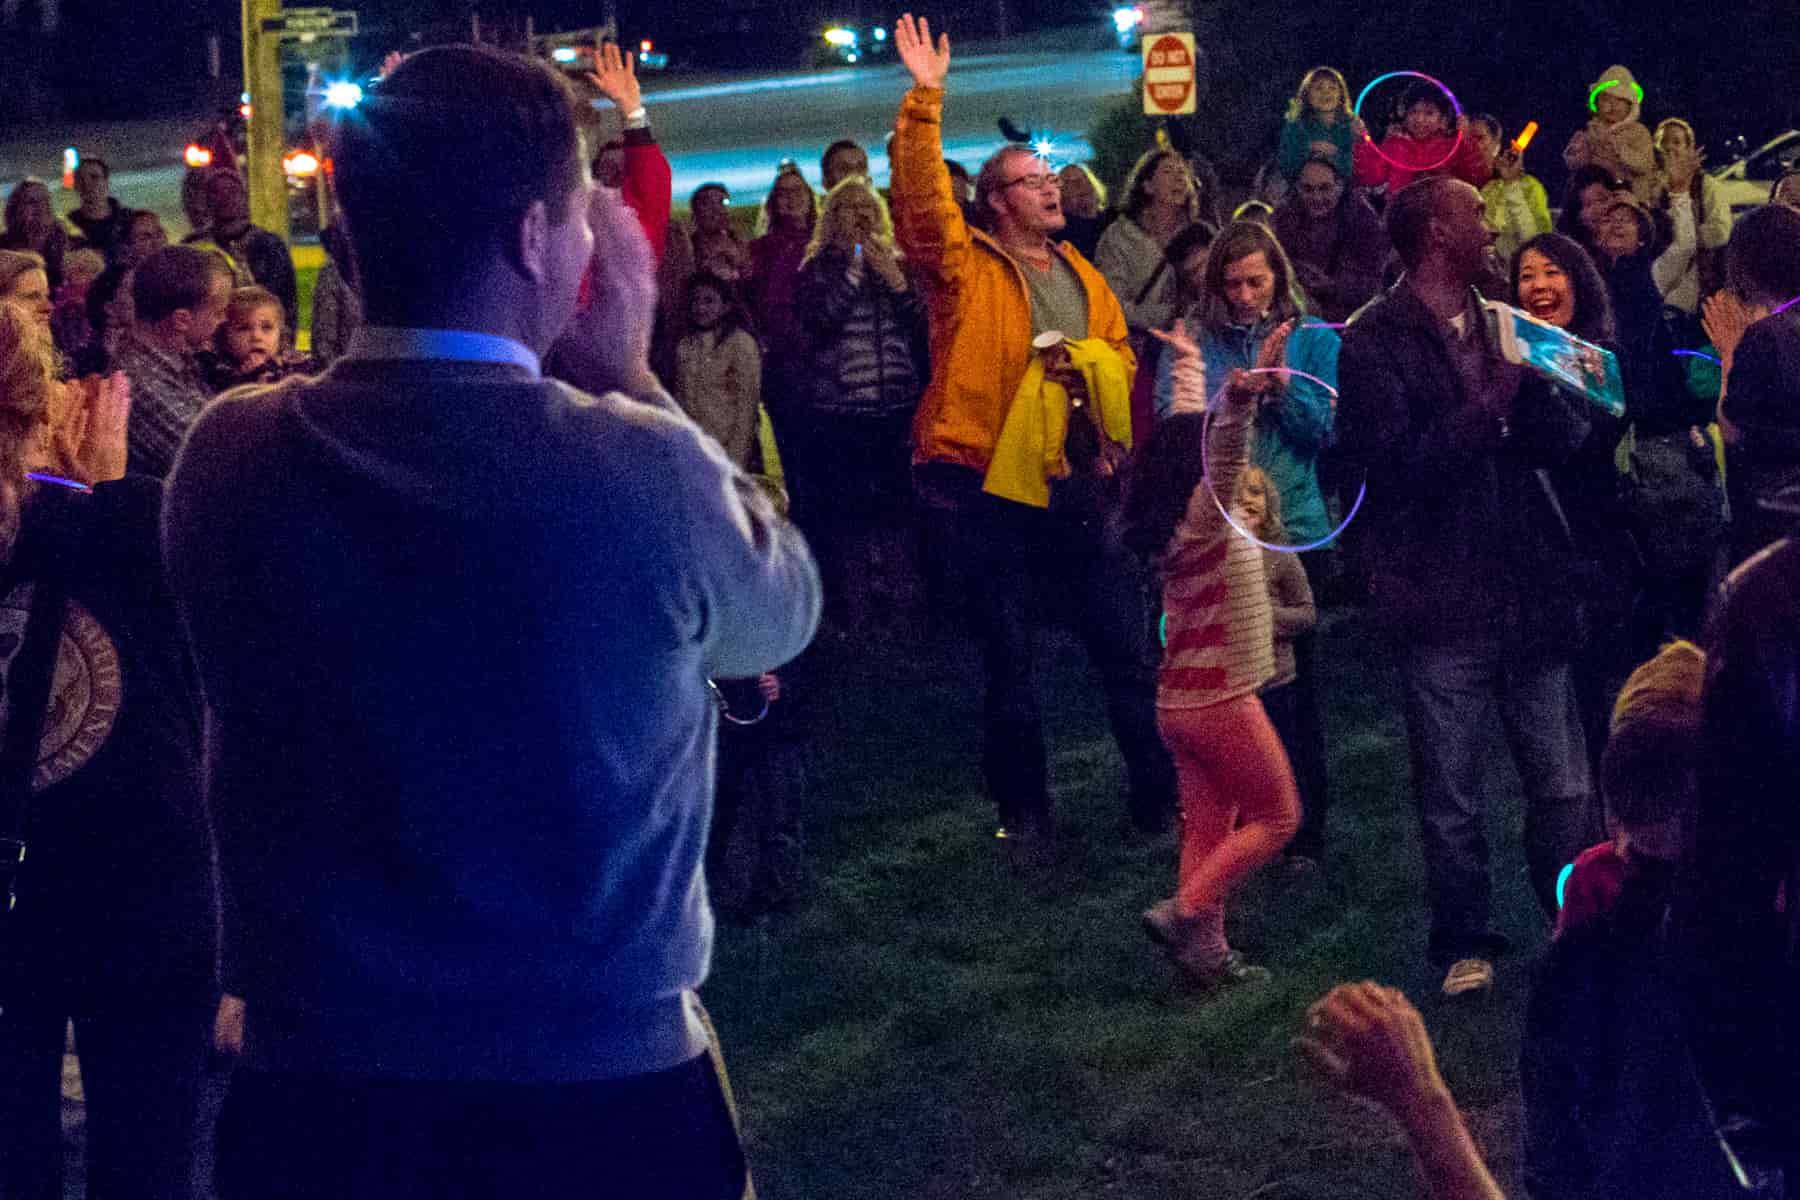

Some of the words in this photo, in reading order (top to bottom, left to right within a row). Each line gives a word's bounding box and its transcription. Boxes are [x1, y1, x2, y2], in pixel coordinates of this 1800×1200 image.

[1151, 50, 1164, 65] DO
[1167, 49, 1185, 64] NOT
[1155, 84, 1184, 99] ENTER
